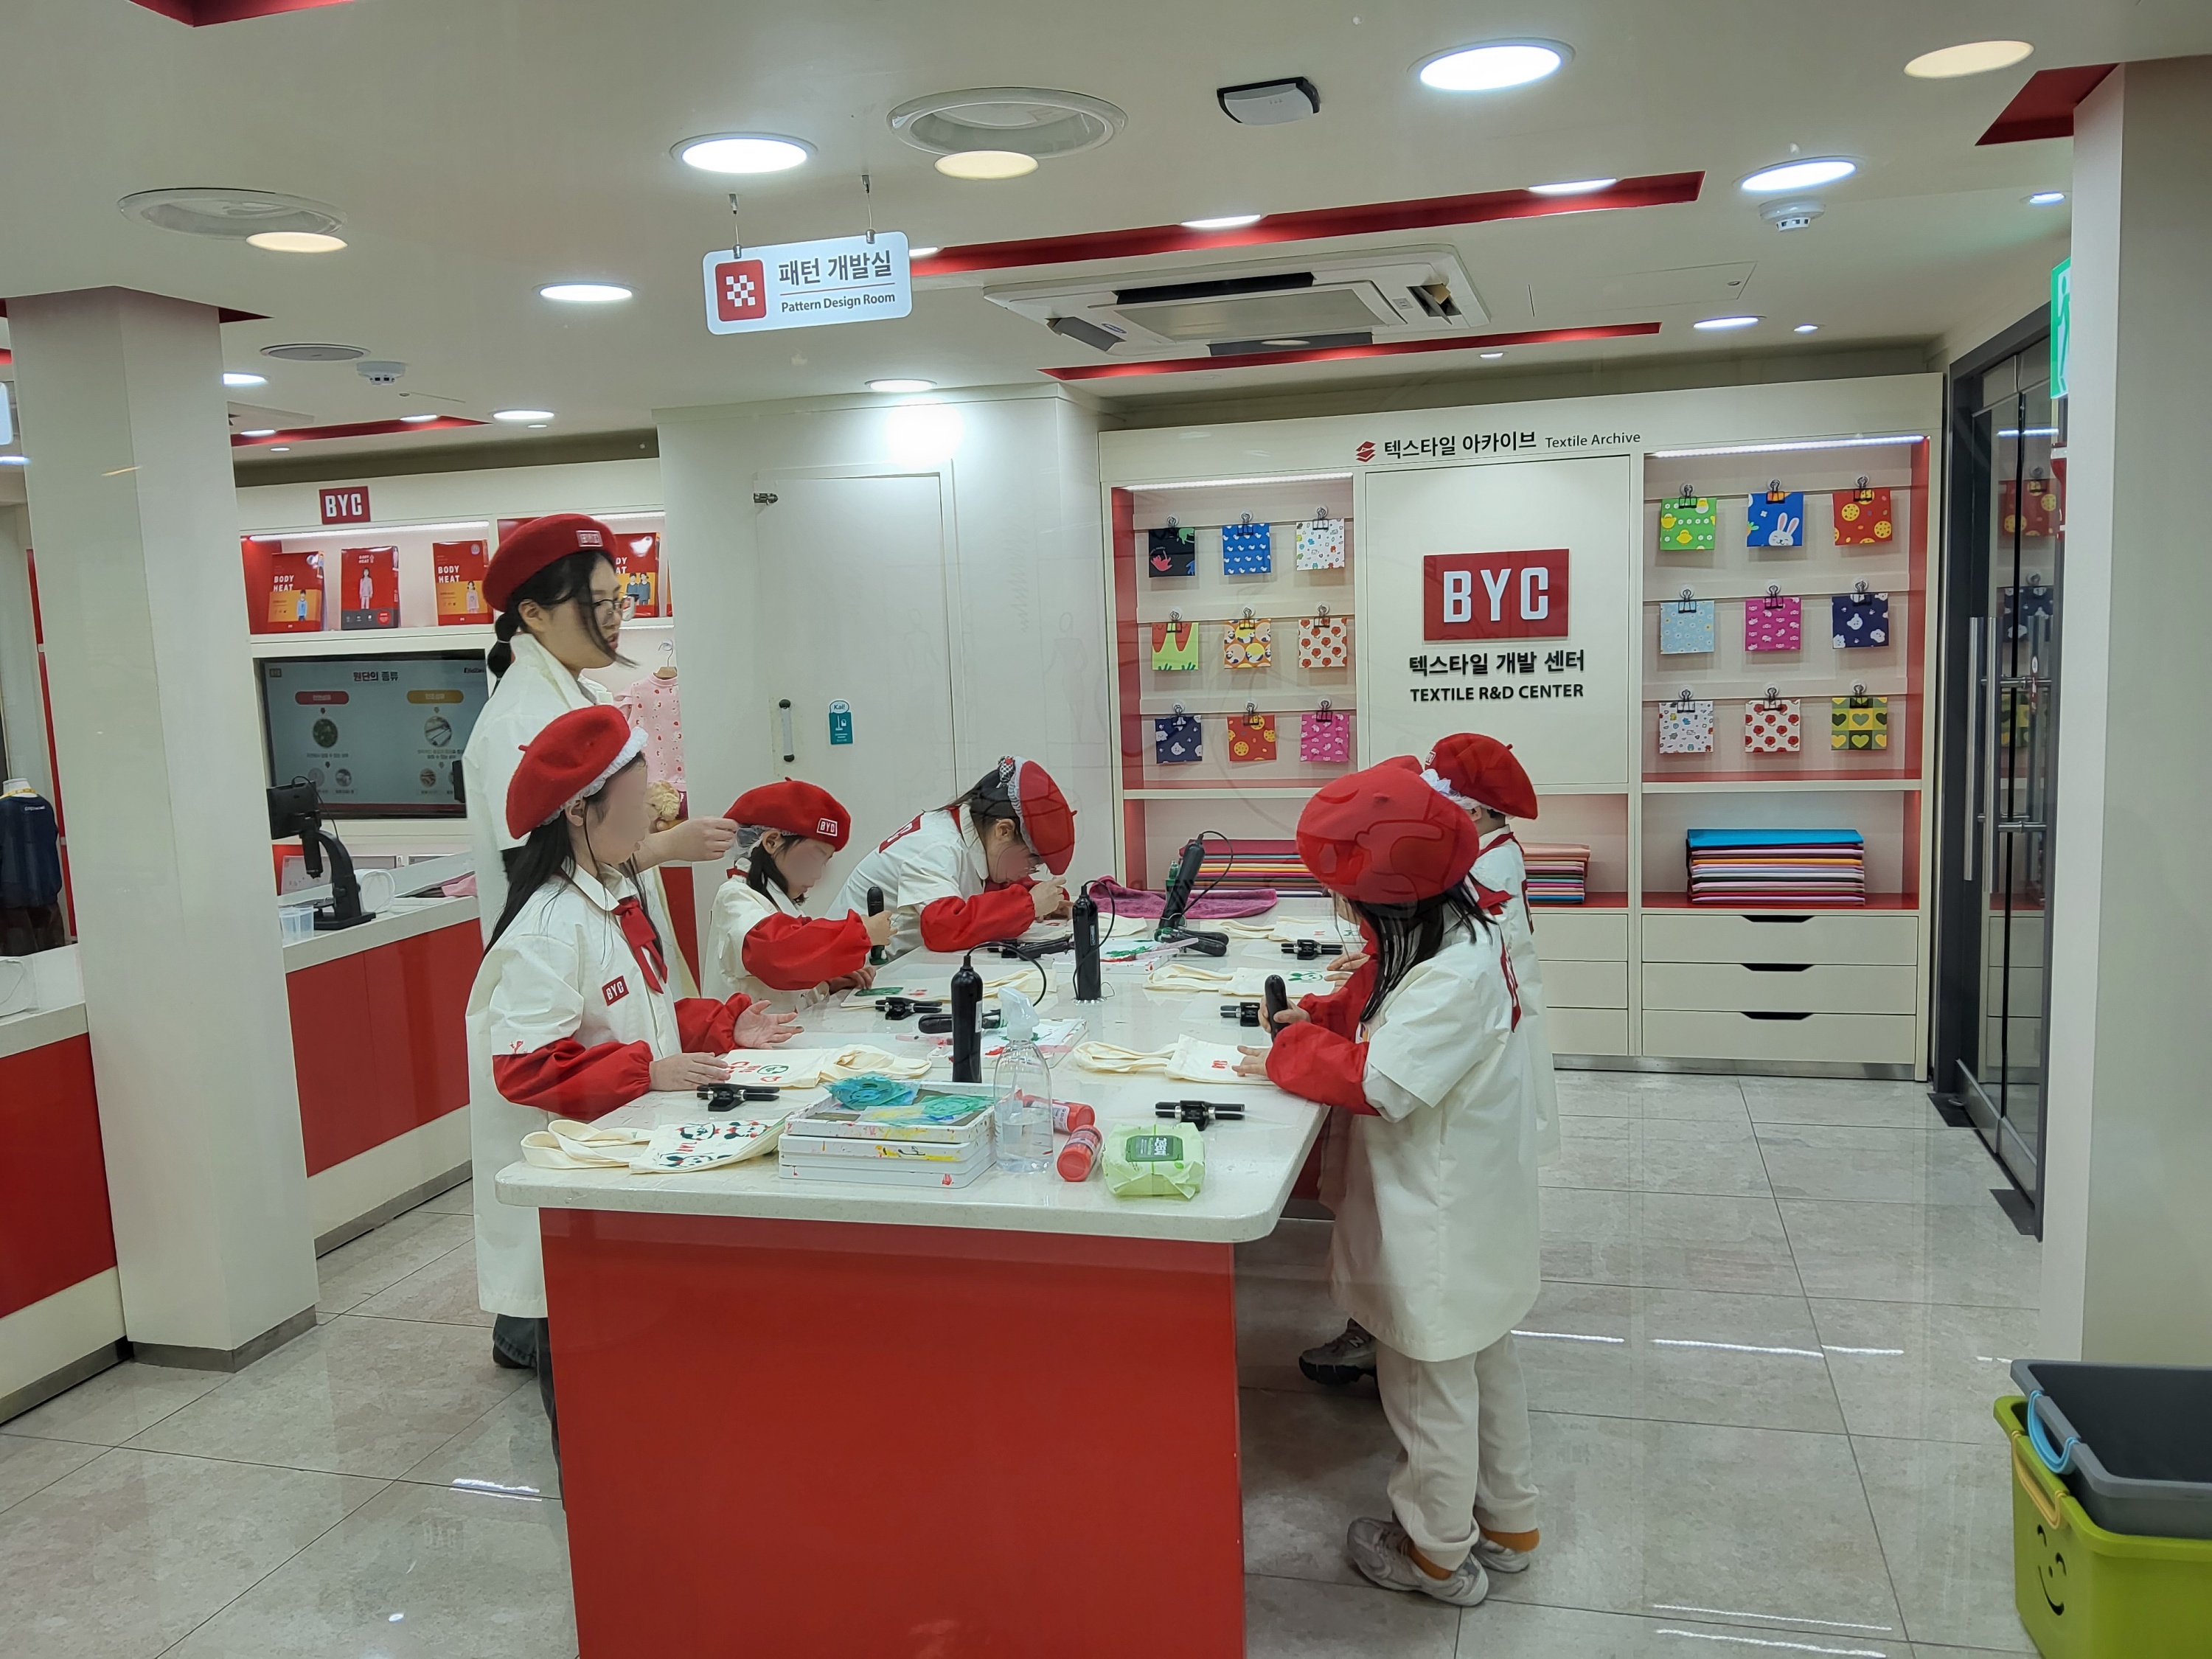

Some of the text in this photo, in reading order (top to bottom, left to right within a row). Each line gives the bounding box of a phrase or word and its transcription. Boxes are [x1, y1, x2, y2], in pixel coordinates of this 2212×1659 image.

[779, 250, 892, 285] 패턴 개발실
[782, 293, 895, 313] Pattern Design Room
[1384, 431, 1537, 459] 텍스타일 아카이브
[1545, 432, 1641, 448] Textile Archive
[324, 493, 363, 518] BYC
[274, 574, 294, 583] BODY
[438, 566, 459, 574] BODY
[438, 575, 460, 583] HEAT
[273, 583, 293, 592] HEAT
[1443, 566, 1548, 623] BYC
[1409, 650, 1585, 676] 텍스타일 개발 센터
[1410, 684, 1584, 701] TEXTILE R&D CENTER
[605, 981, 625, 1001] BYC
